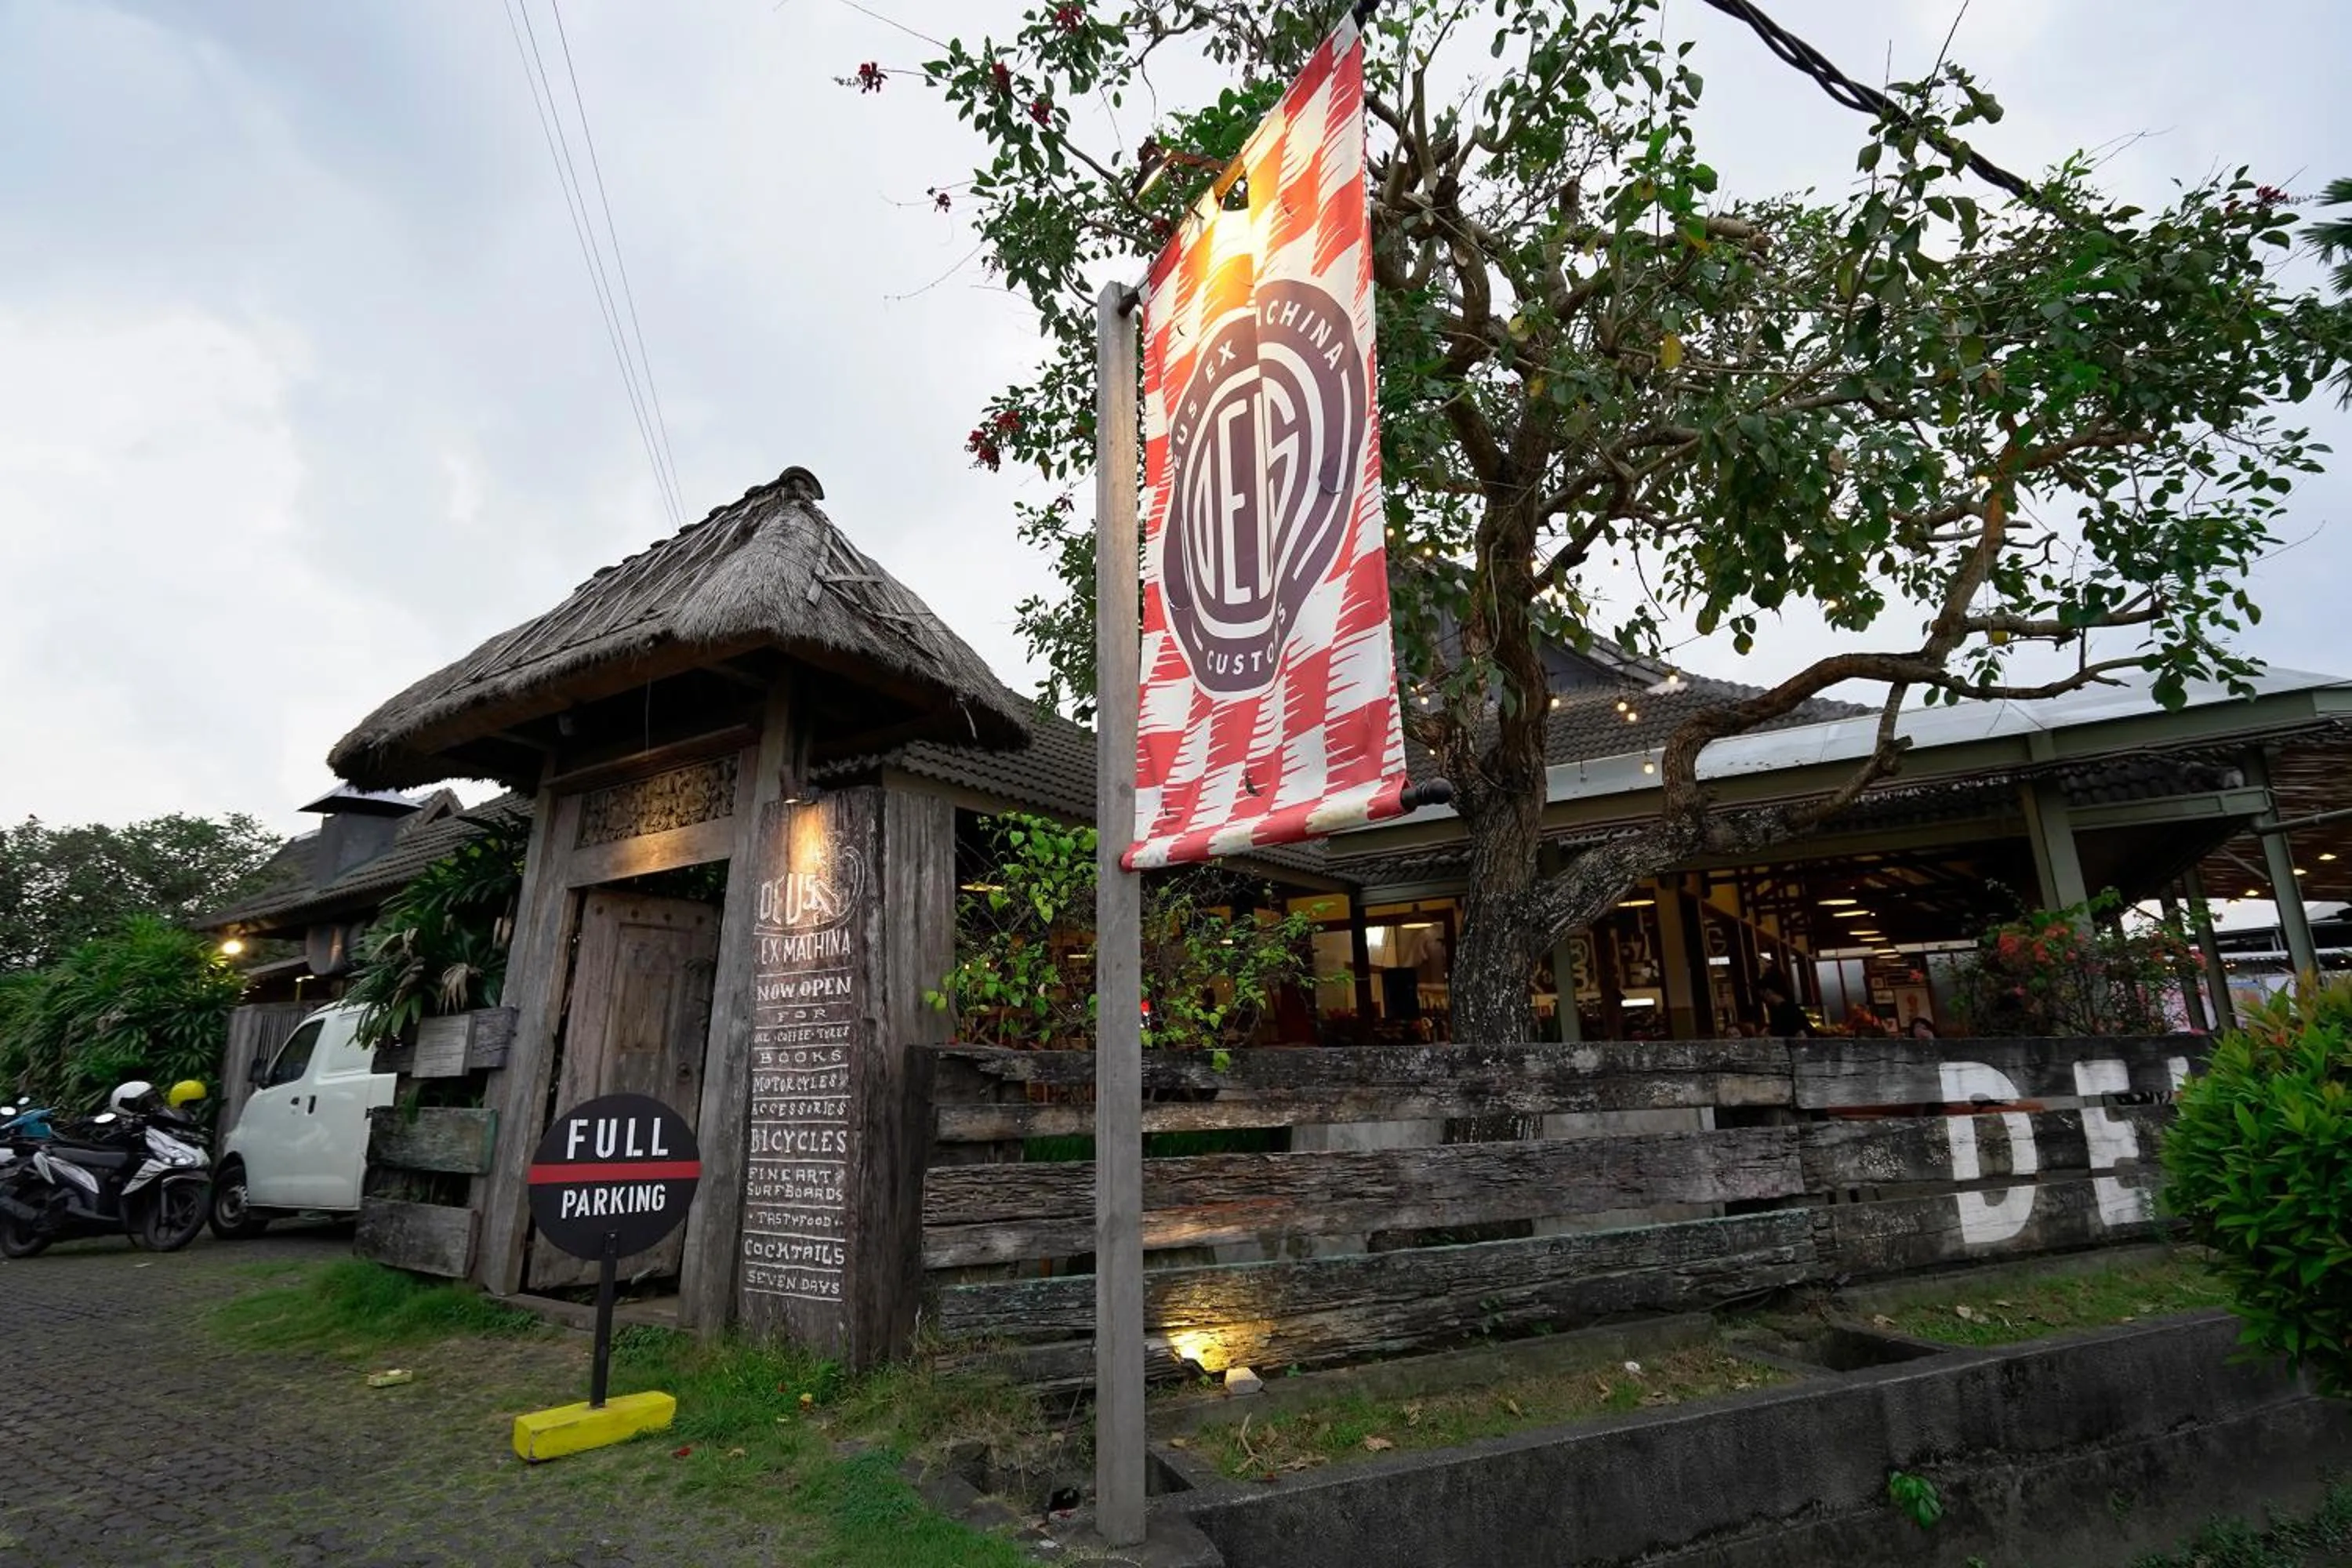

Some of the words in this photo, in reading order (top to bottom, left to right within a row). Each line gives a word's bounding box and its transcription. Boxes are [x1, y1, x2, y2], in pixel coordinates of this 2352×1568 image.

[1205, 339, 1236, 383] EX
[1207, 601, 1287, 675] CUSTOS
[761, 938, 779, 965] EX
[784, 927, 851, 963] MACHINA
[757, 982, 796, 1001] NOW
[799, 976, 852, 997] OPEN
[760, 1050, 842, 1064] BOOKS
[566, 1116, 669, 1160] FULL
[750, 1126, 848, 1153] BICYCLES
[1940, 1056, 2190, 1243] DE
[748, 1167, 792, 1181] FINE
[795, 1169, 833, 1184] ART
[561, 1184, 666, 1219] PARKING
[746, 1181, 844, 1202] SURFBOARDS
[744, 1239, 845, 1265] COCKTAILS
[747, 1270, 797, 1290] SEVEN
[800, 1277, 840, 1294] DAYS
